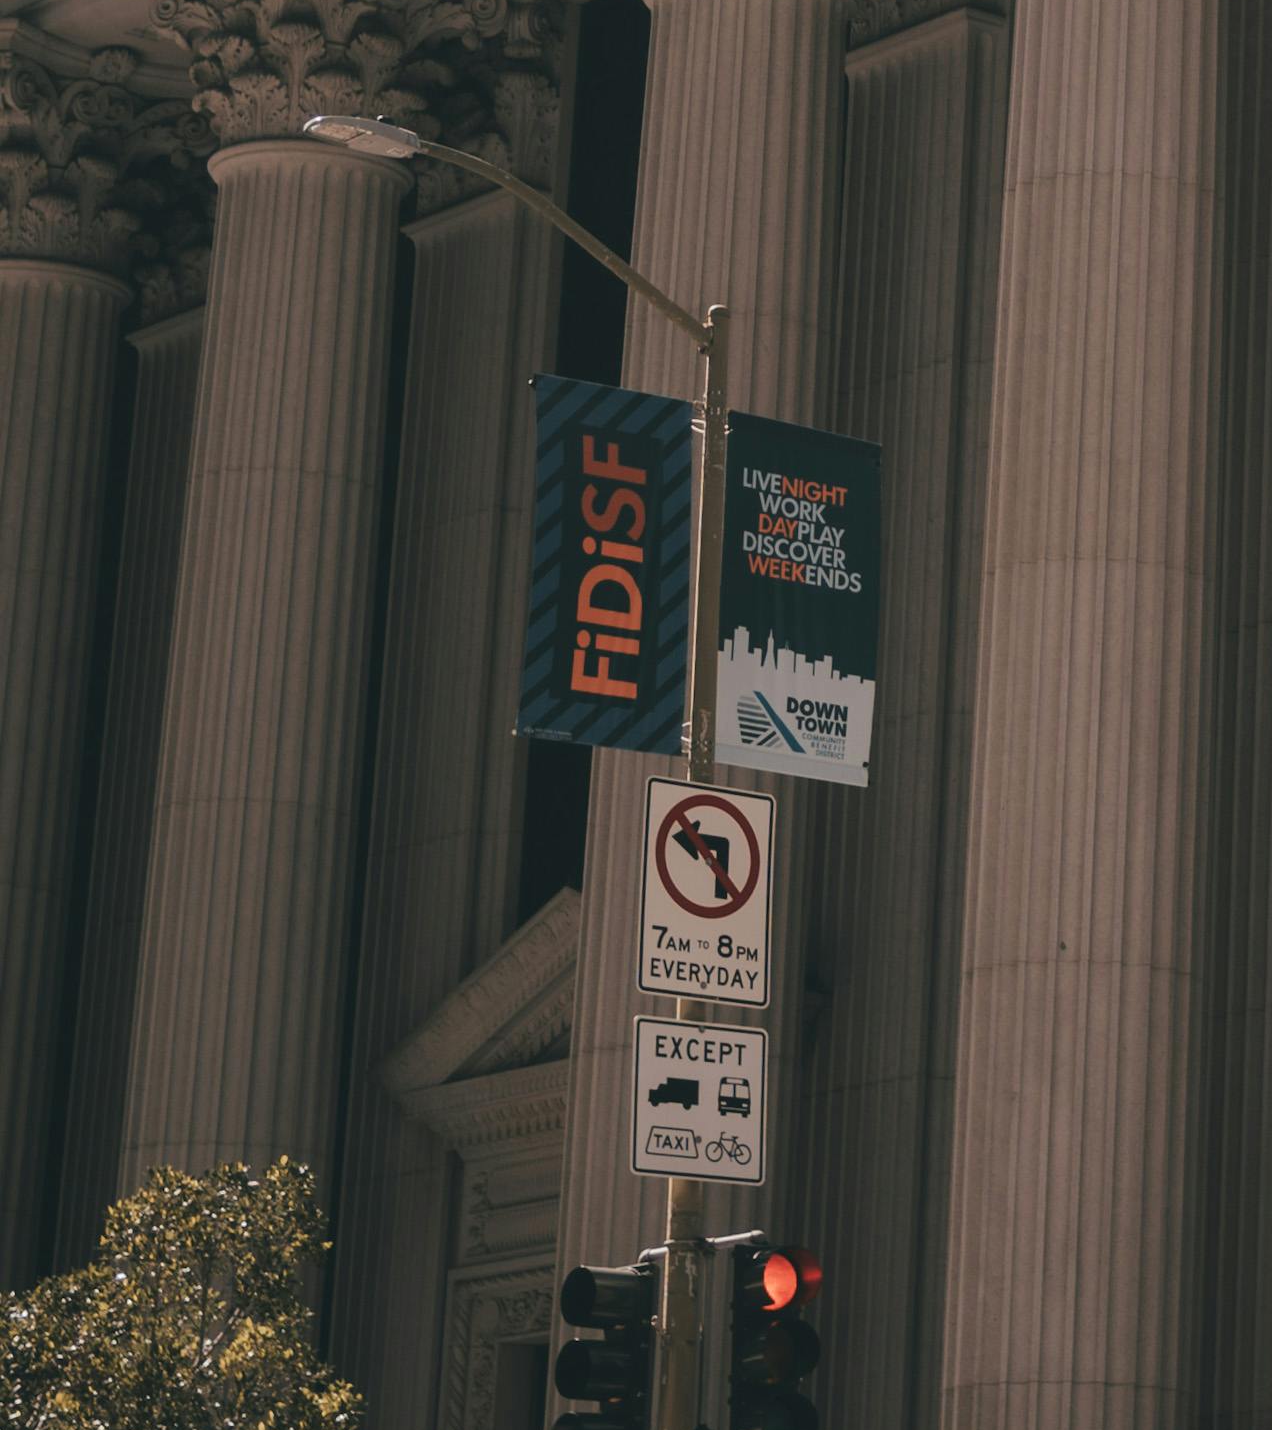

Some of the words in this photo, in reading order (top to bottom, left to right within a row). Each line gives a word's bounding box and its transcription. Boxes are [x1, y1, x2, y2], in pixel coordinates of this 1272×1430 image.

[759, 492, 826, 524] WORK
[743, 530, 846, 570] DISCOVER
[570, 434, 647, 700] FiDiSF
[748, 553, 862, 594] WEEKENDS
[786, 696, 849, 722] DOWN
[796, 716, 848, 737] TOWN
[801, 733, 846, 745] COMMUNITY
[810, 741, 846, 752] BENEFIT
[815, 749, 845, 760] DISTRICT
[652, 925, 691, 953] 7AM
[698, 940, 710, 950] TO
[650, 957, 759, 990] EVERYDAY
[656, 1035, 747, 1066] EXCEPT
[653, 1134, 689, 1152] TAXI
